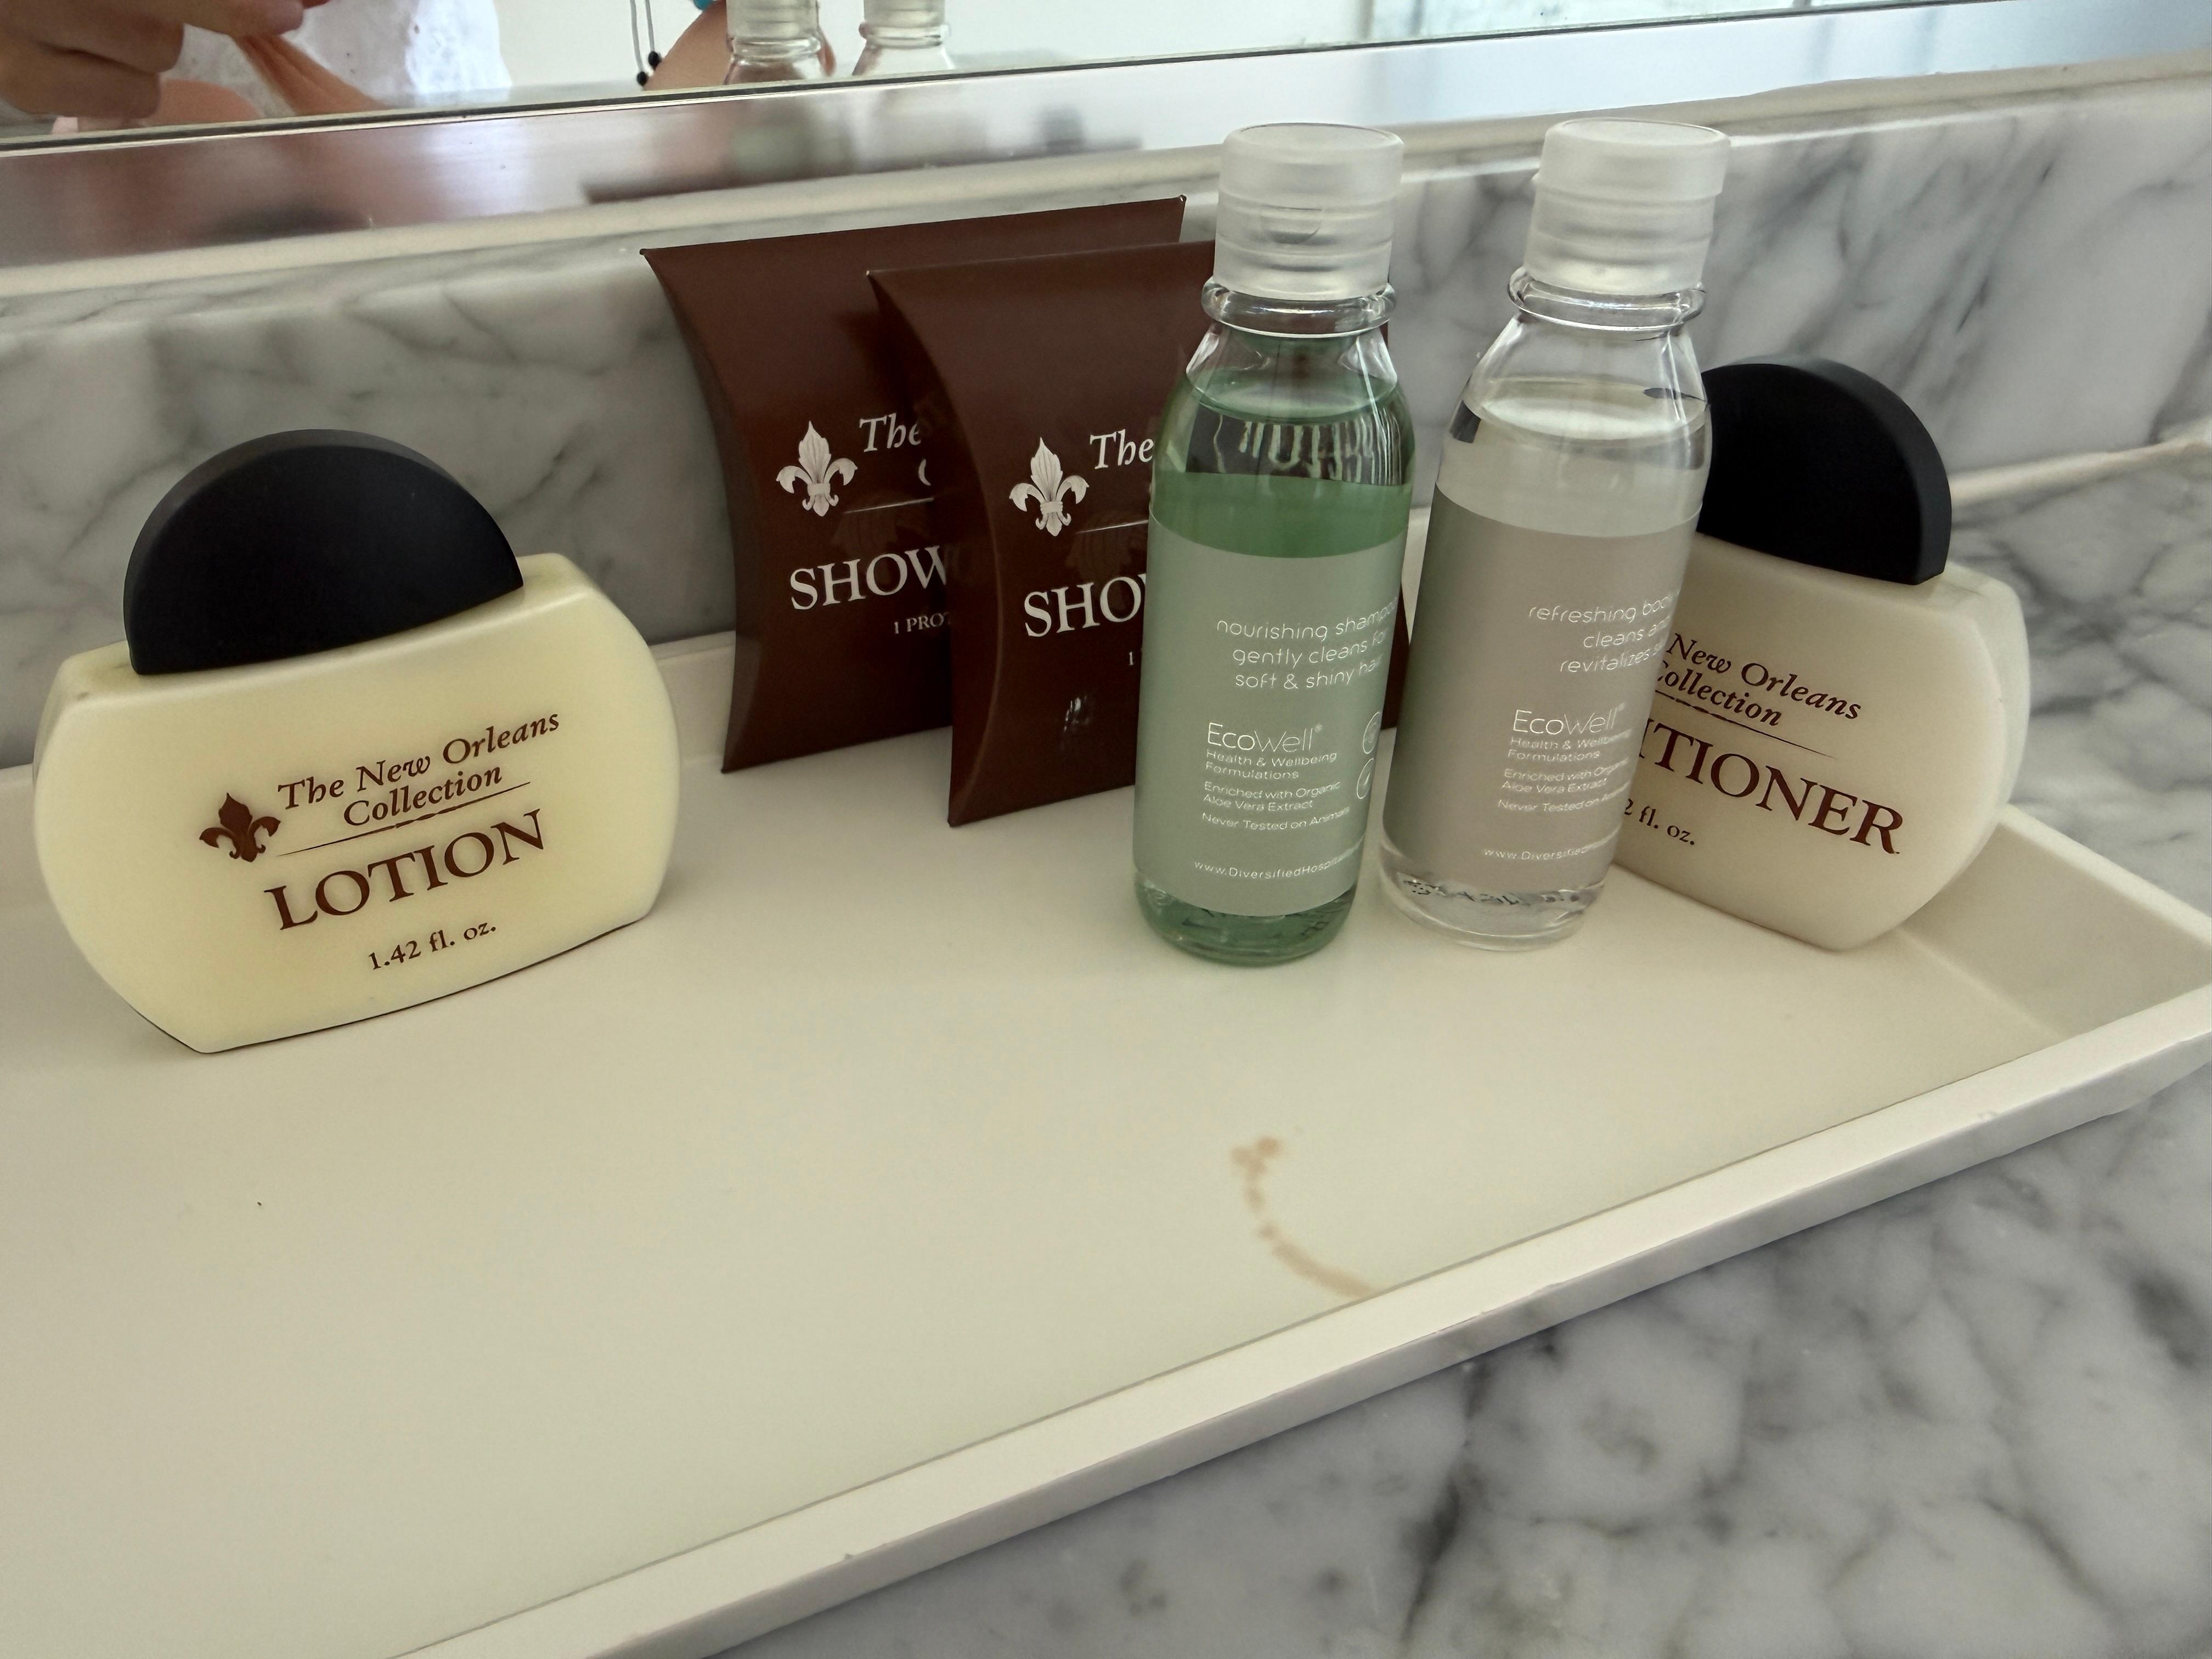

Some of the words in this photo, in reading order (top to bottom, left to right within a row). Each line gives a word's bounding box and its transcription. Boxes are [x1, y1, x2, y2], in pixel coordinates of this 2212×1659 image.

[1090, 428, 1154, 470] The
[1024, 572, 1147, 638] SHO
[1530, 606, 1635, 623] refreshing
[1217, 620, 1328, 641] nourishing
[1584, 629, 1644, 647] cleans
[1233, 649, 1302, 668] gently
[1309, 641, 1367, 664] cleans
[1372, 628, 1388, 646] fo
[1560, 647, 1650, 672] revitalizes
[1235, 674, 1277, 689] soft
[1283, 674, 1299, 689] &
[1306, 668, 1355, 688] shiny
[1666, 633, 1731, 674] New
[1741, 662, 1861, 719] Orleans
[1510, 737, 1558, 749] Health
[1563, 741, 1571, 749] &
[278, 776, 344, 809] The
[356, 755, 431, 792] New
[442, 713, 560, 764] Orleans
[1207, 749, 1252, 765] Health
[1256, 757, 1266, 766] &
[1272, 753, 1338, 767] Wellbeing
[1508, 749, 1600, 761] Formulations
[1206, 761, 1299, 780] Formulations
[343, 766, 503, 826] Collection
[1205, 781, 1263, 799] Enriched
[1265, 790, 1293, 799] with
[1203, 794, 1231, 808] Aloe
[1235, 800, 1264, 811] Vera
[1268, 800, 1313, 811] Extract
[1498, 799, 1538, 810] Never
[1202, 812, 1239, 827] Never
[1243, 820, 1288, 830] Tested
[1291, 821, 1306, 830] on
[1639, 806, 1658, 829] fl.
[1667, 825, 1695, 845] oz.
[264, 808, 544, 930] LOTION
[368, 940, 422, 970] 1.42
[428, 931, 455, 952] fl.
[463, 922, 496, 940] oz.
